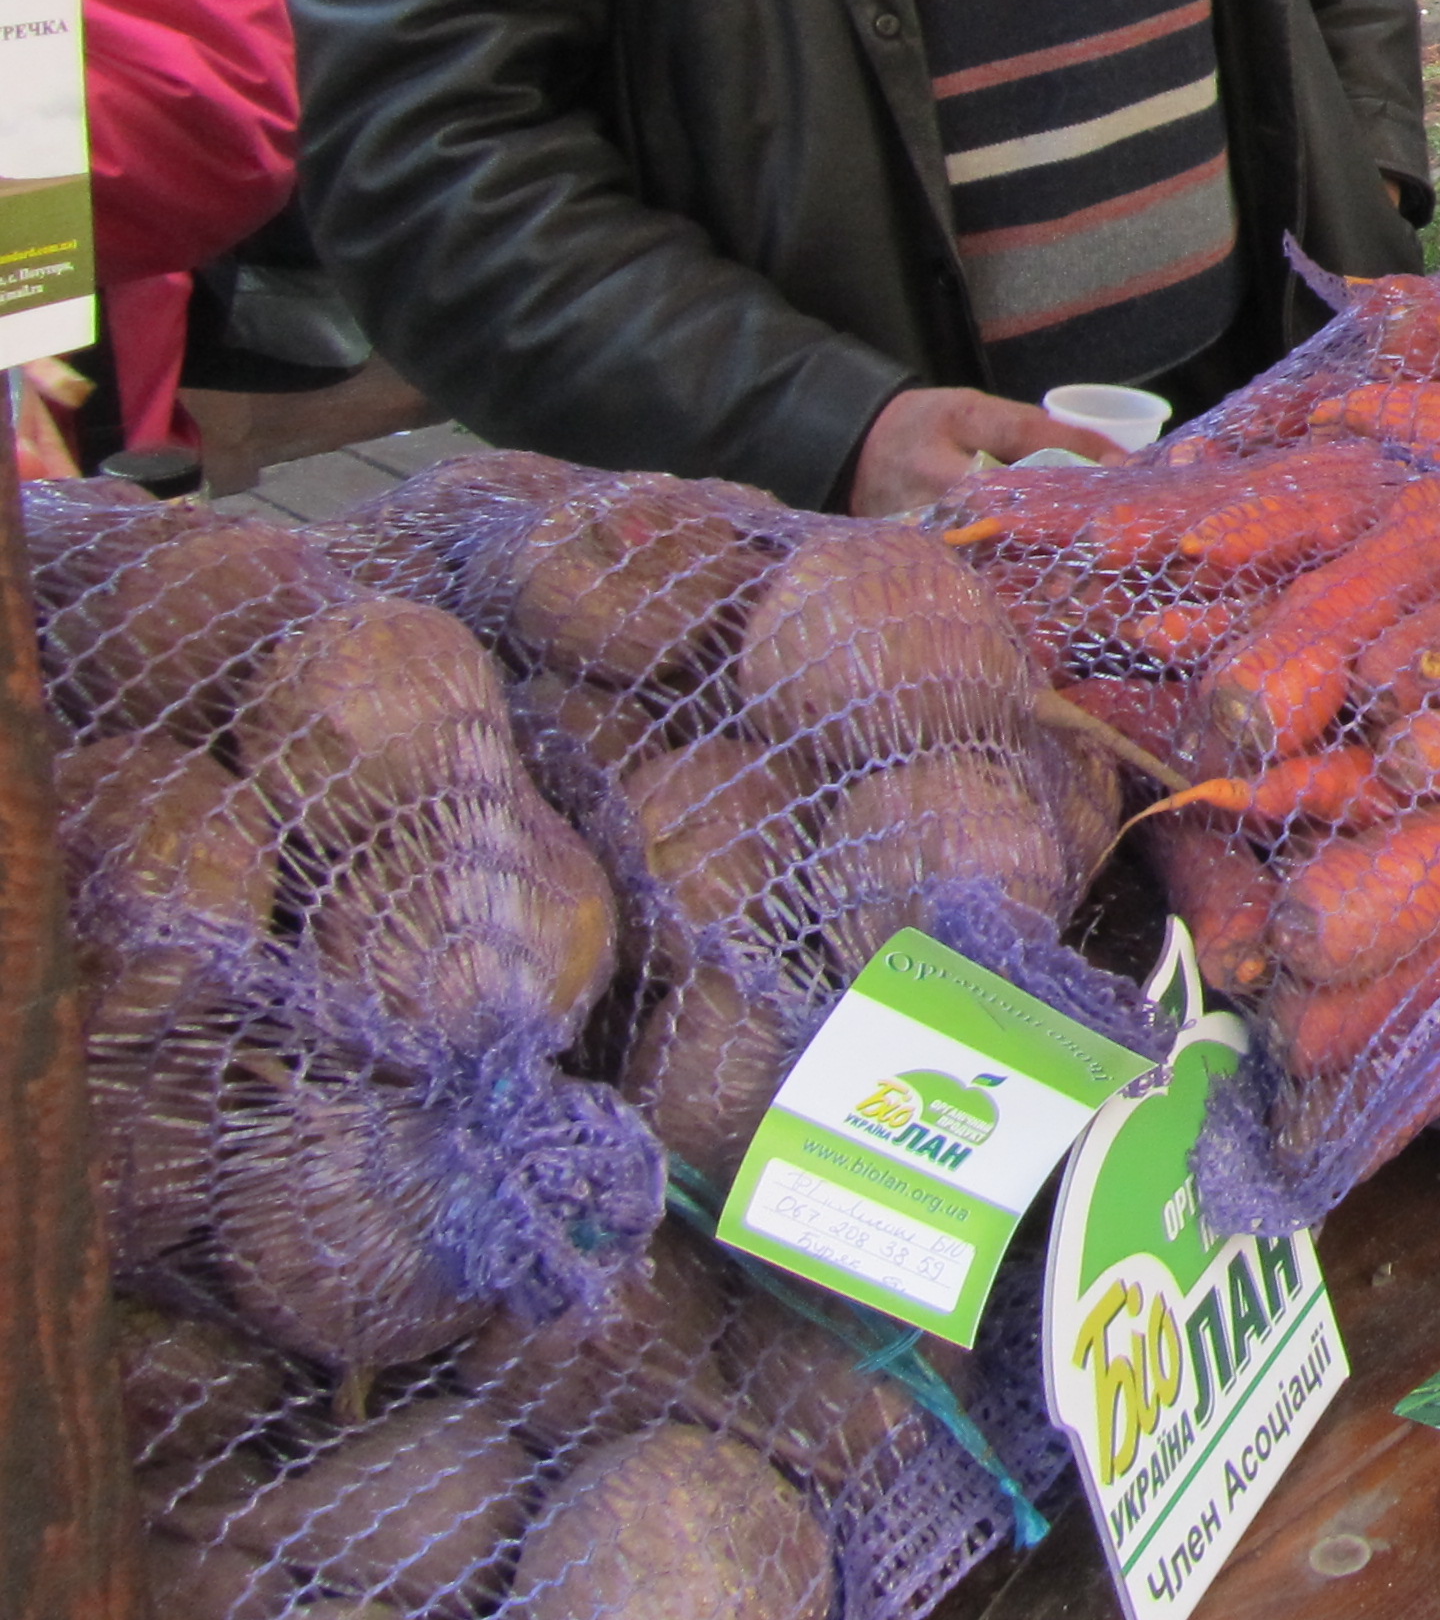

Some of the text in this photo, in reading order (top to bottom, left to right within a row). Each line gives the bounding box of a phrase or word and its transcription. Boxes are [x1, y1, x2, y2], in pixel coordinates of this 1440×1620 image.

[843, 1112, 894, 1142] УКРАЇНА
[891, 1121, 974, 1172] ЛАН
[801, 1137, 971, 1223] www.biolan.org.ua
[828, 1219, 871, 1250] 208
[879, 1239, 911, 1267] 38
[915, 1255, 947, 1284] 59
[1071, 1235, 1304, 1486] Біо ЛАН
[1109, 1410, 1196, 1549] УКРАЇНА
[1147, 1322, 1334, 1603] Член Асоціації
